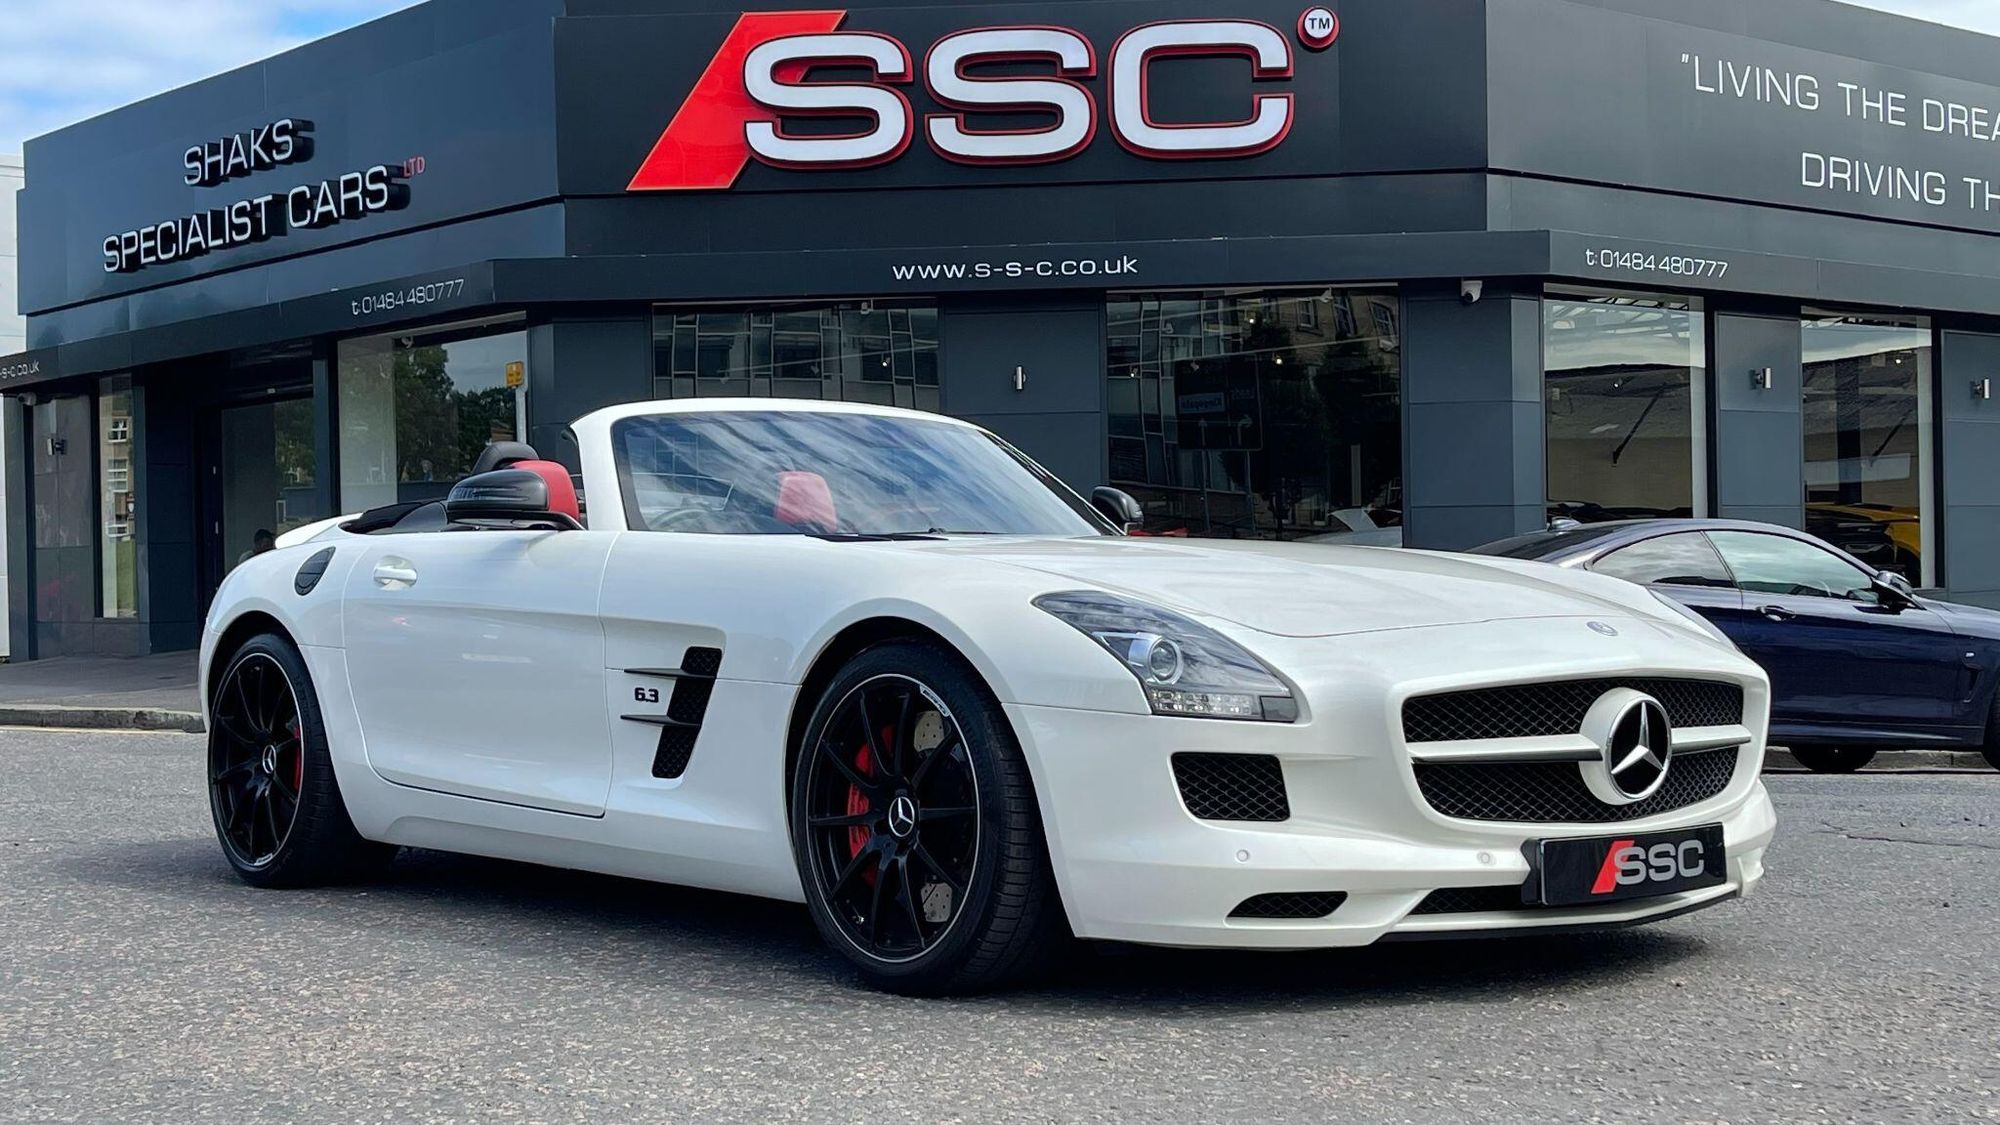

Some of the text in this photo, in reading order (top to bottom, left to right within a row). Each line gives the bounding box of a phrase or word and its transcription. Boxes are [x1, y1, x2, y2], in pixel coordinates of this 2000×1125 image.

[742, 17, 1331, 170] SSC TM
[1837, 82, 1906, 126] THE
[183, 117, 294, 186] SHAKS
[1802, 151, 1946, 205] DRIVING
[103, 156, 426, 273] SPECIALIST CARS LTD
[892, 255, 1139, 280] www.s-s-c.co.uk
[1658, 255, 1729, 279] 480777
[406, 278, 465, 304] 480777
[1614, 839, 1704, 885] SSC
